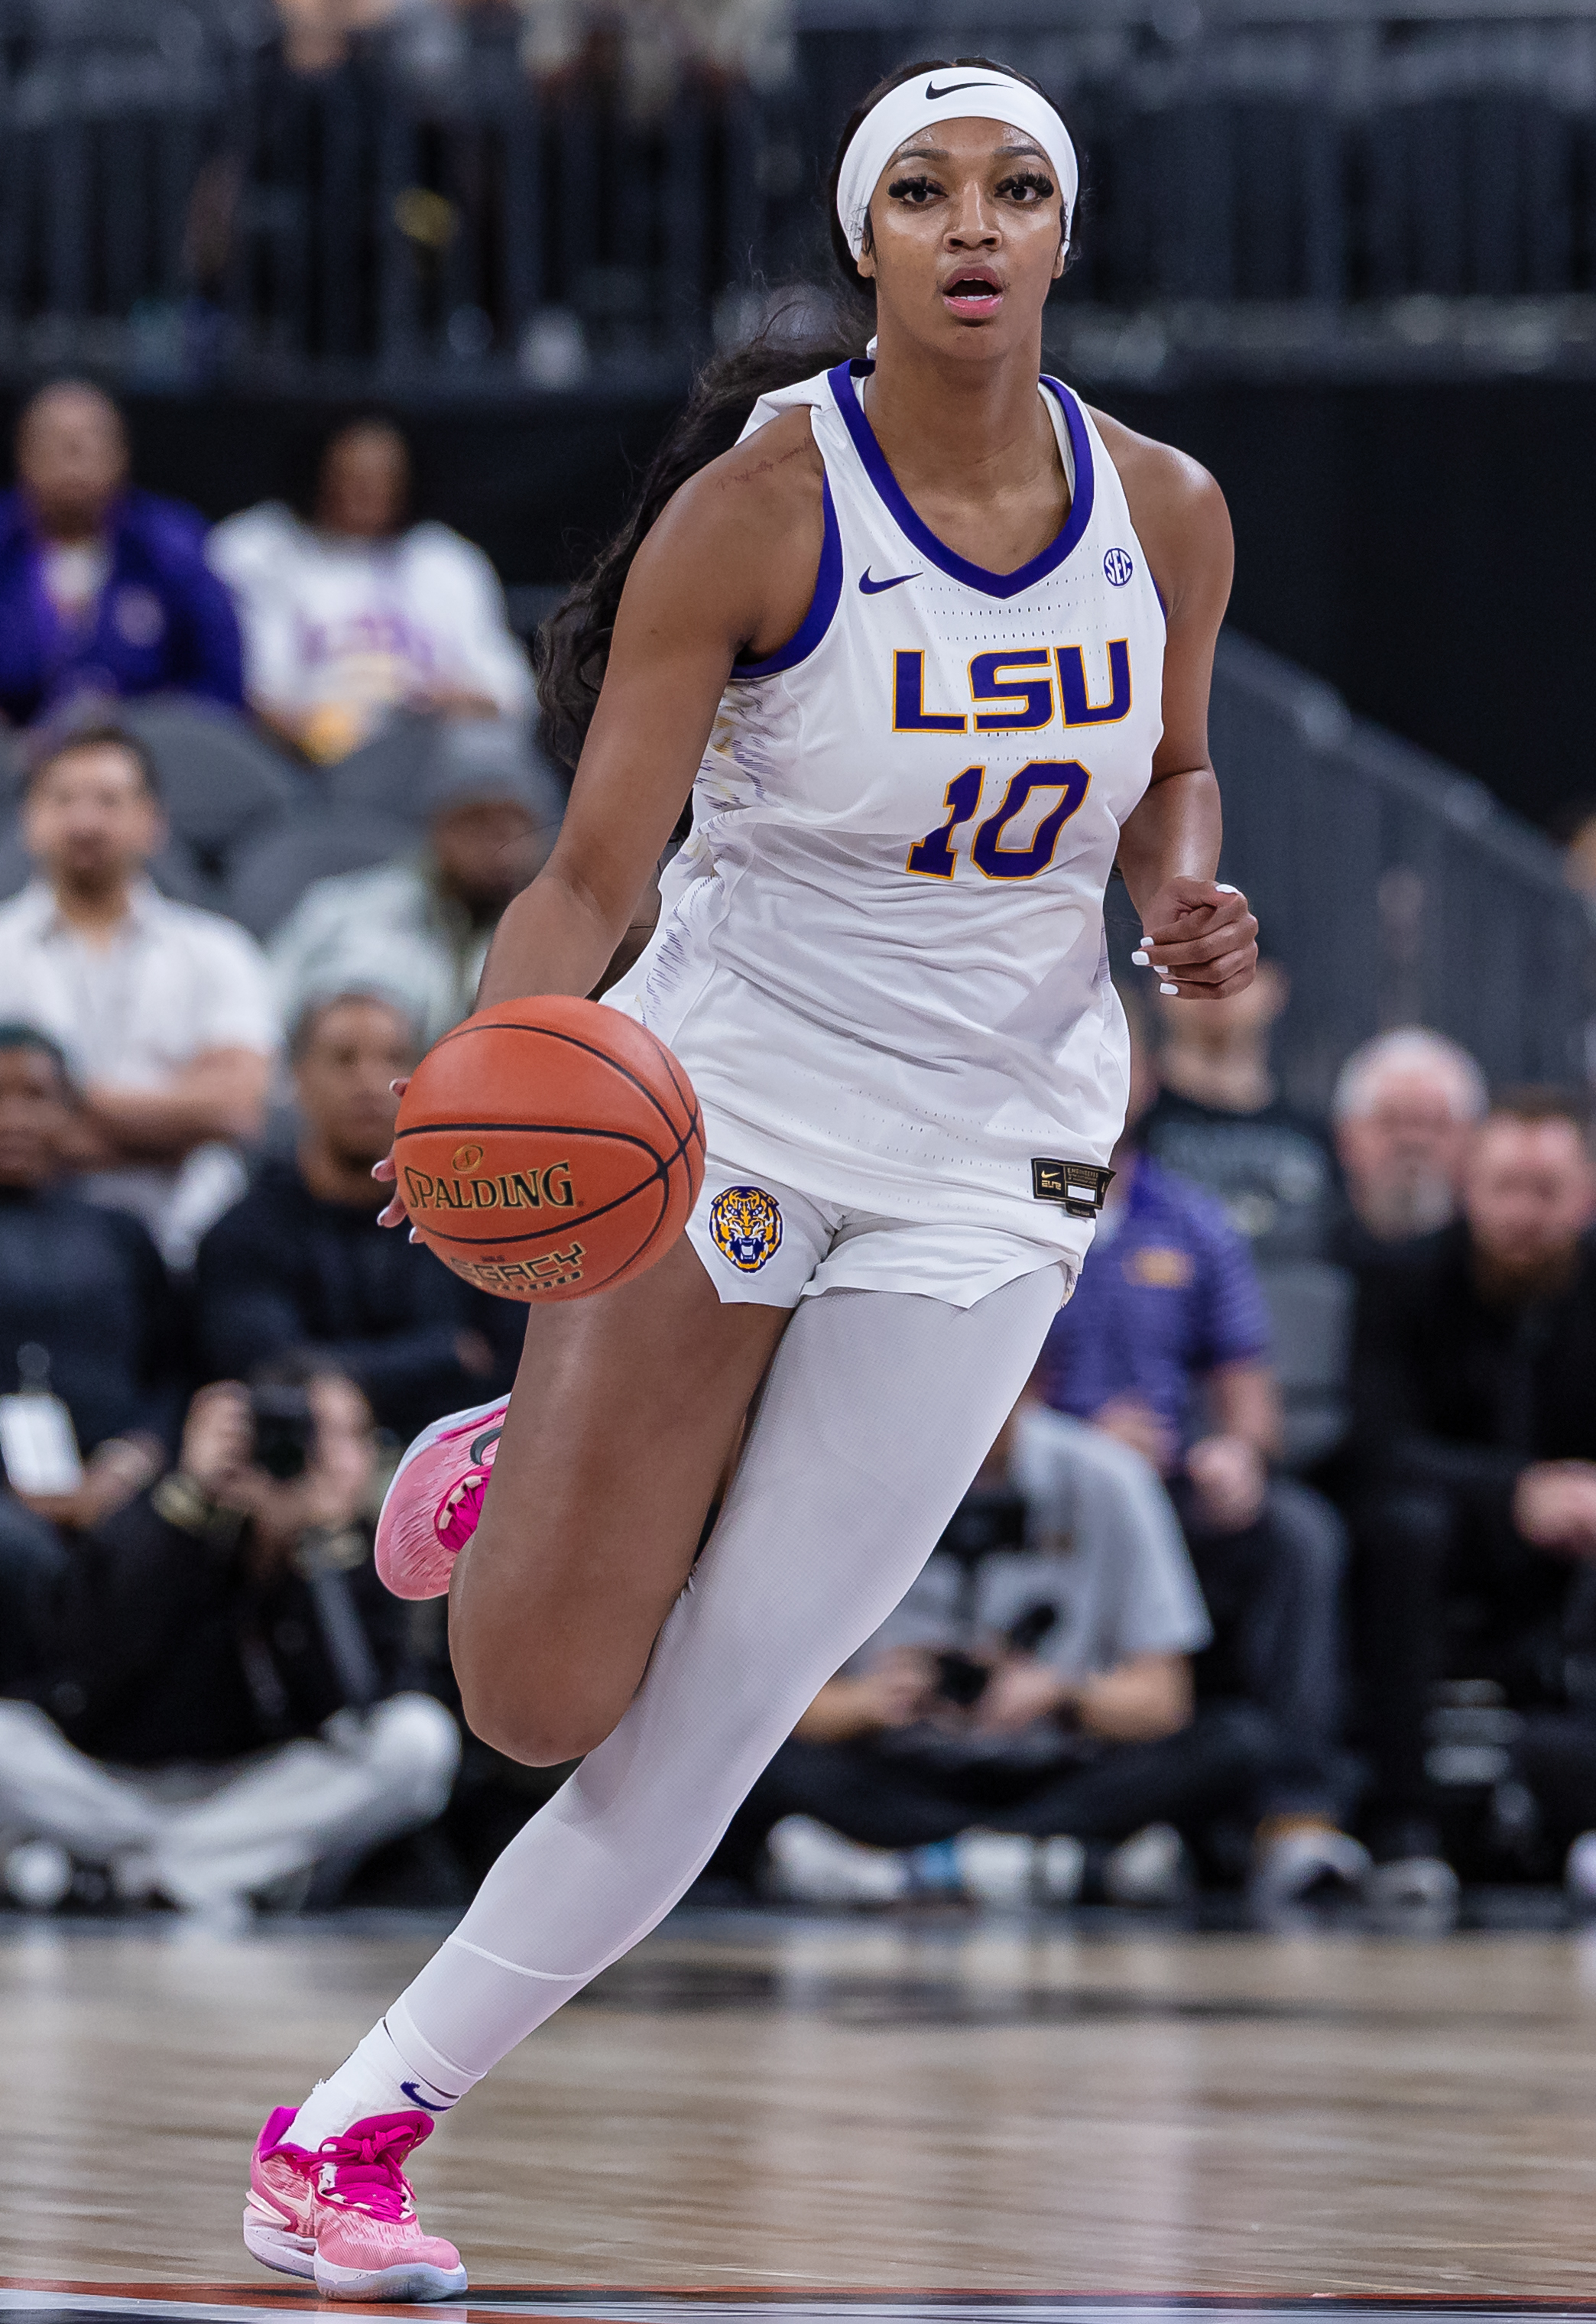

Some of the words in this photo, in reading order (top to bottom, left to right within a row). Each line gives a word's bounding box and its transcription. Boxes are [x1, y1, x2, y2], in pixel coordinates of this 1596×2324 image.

[1105, 550, 1131, 584] SEC
[892, 638, 1133, 733] LSU
[907, 759, 1092, 880] 10
[404, 1160, 576, 1209] SPALDING
[449, 1241, 586, 1282] EGACY
